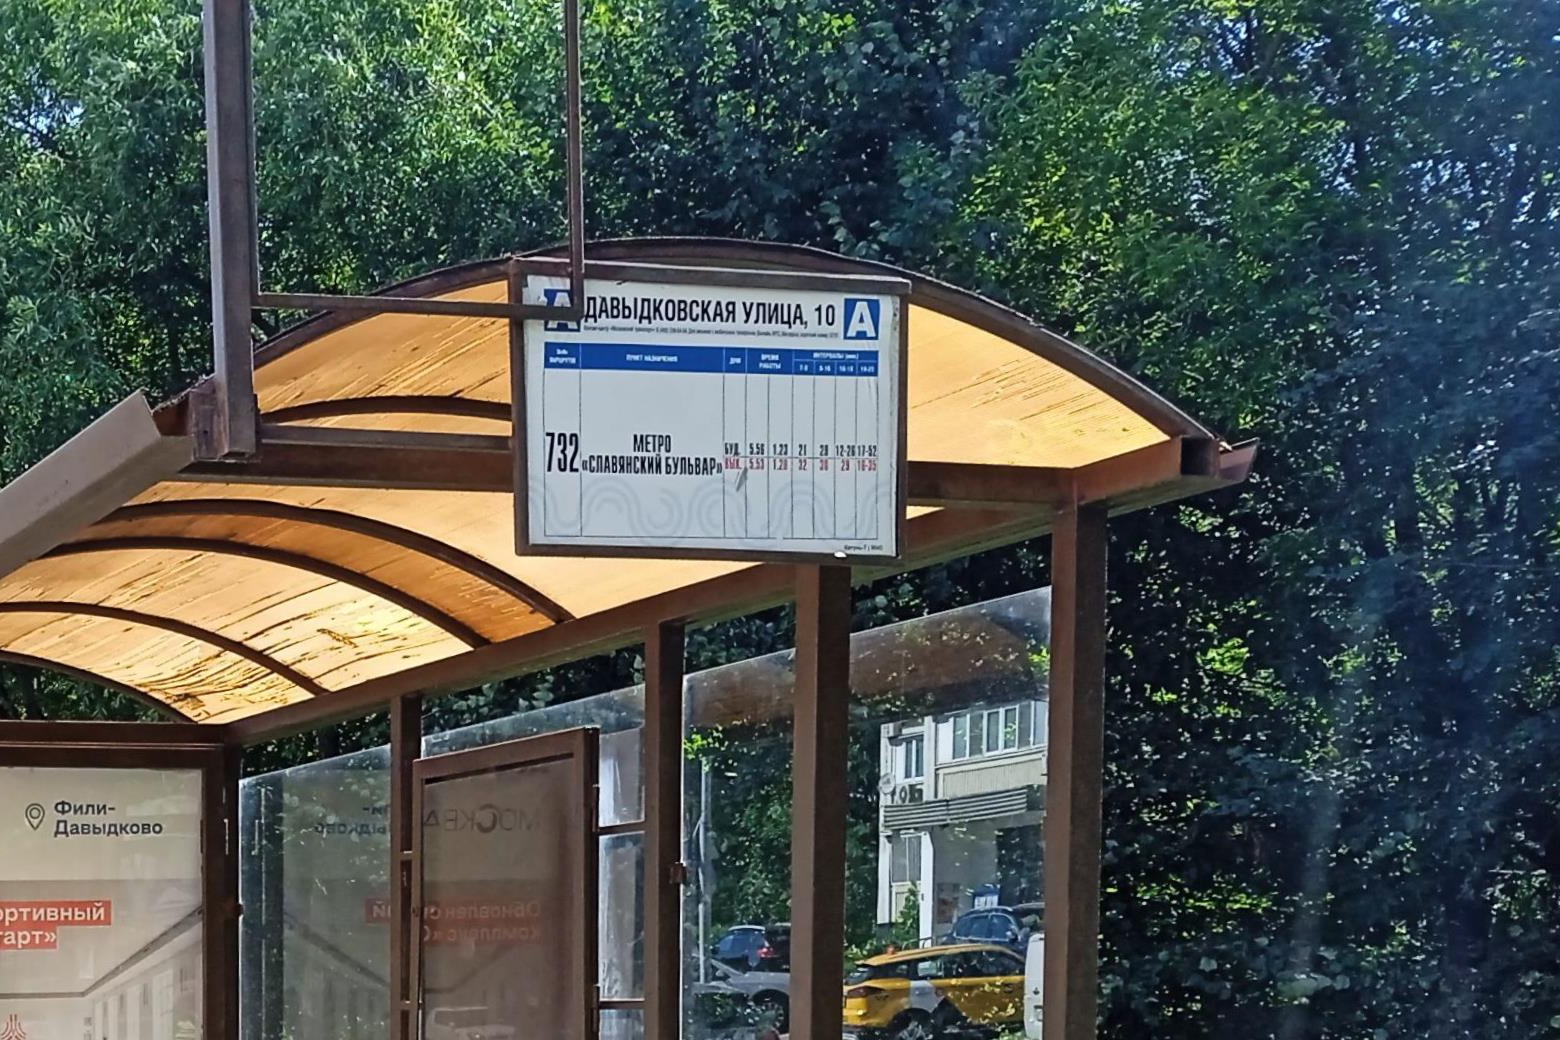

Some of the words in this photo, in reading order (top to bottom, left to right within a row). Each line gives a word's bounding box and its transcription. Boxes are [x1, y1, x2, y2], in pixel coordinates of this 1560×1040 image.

[584, 296, 736, 325] ДАВЫДКОВСКАЯ
[742, 301, 808, 329] УЛИЦА,
[815, 304, 835, 326] 10
[545, 432, 579, 473] 732
[633, 434, 672, 453] МЕТРО
[582, 453, 662, 474] «СЛАВЯНСКИЙ
[665, 457, 723, 476] БУЛЬВАР»
[54, 801, 116, 817] Фили-
[54, 820, 163, 838] Давыдково
